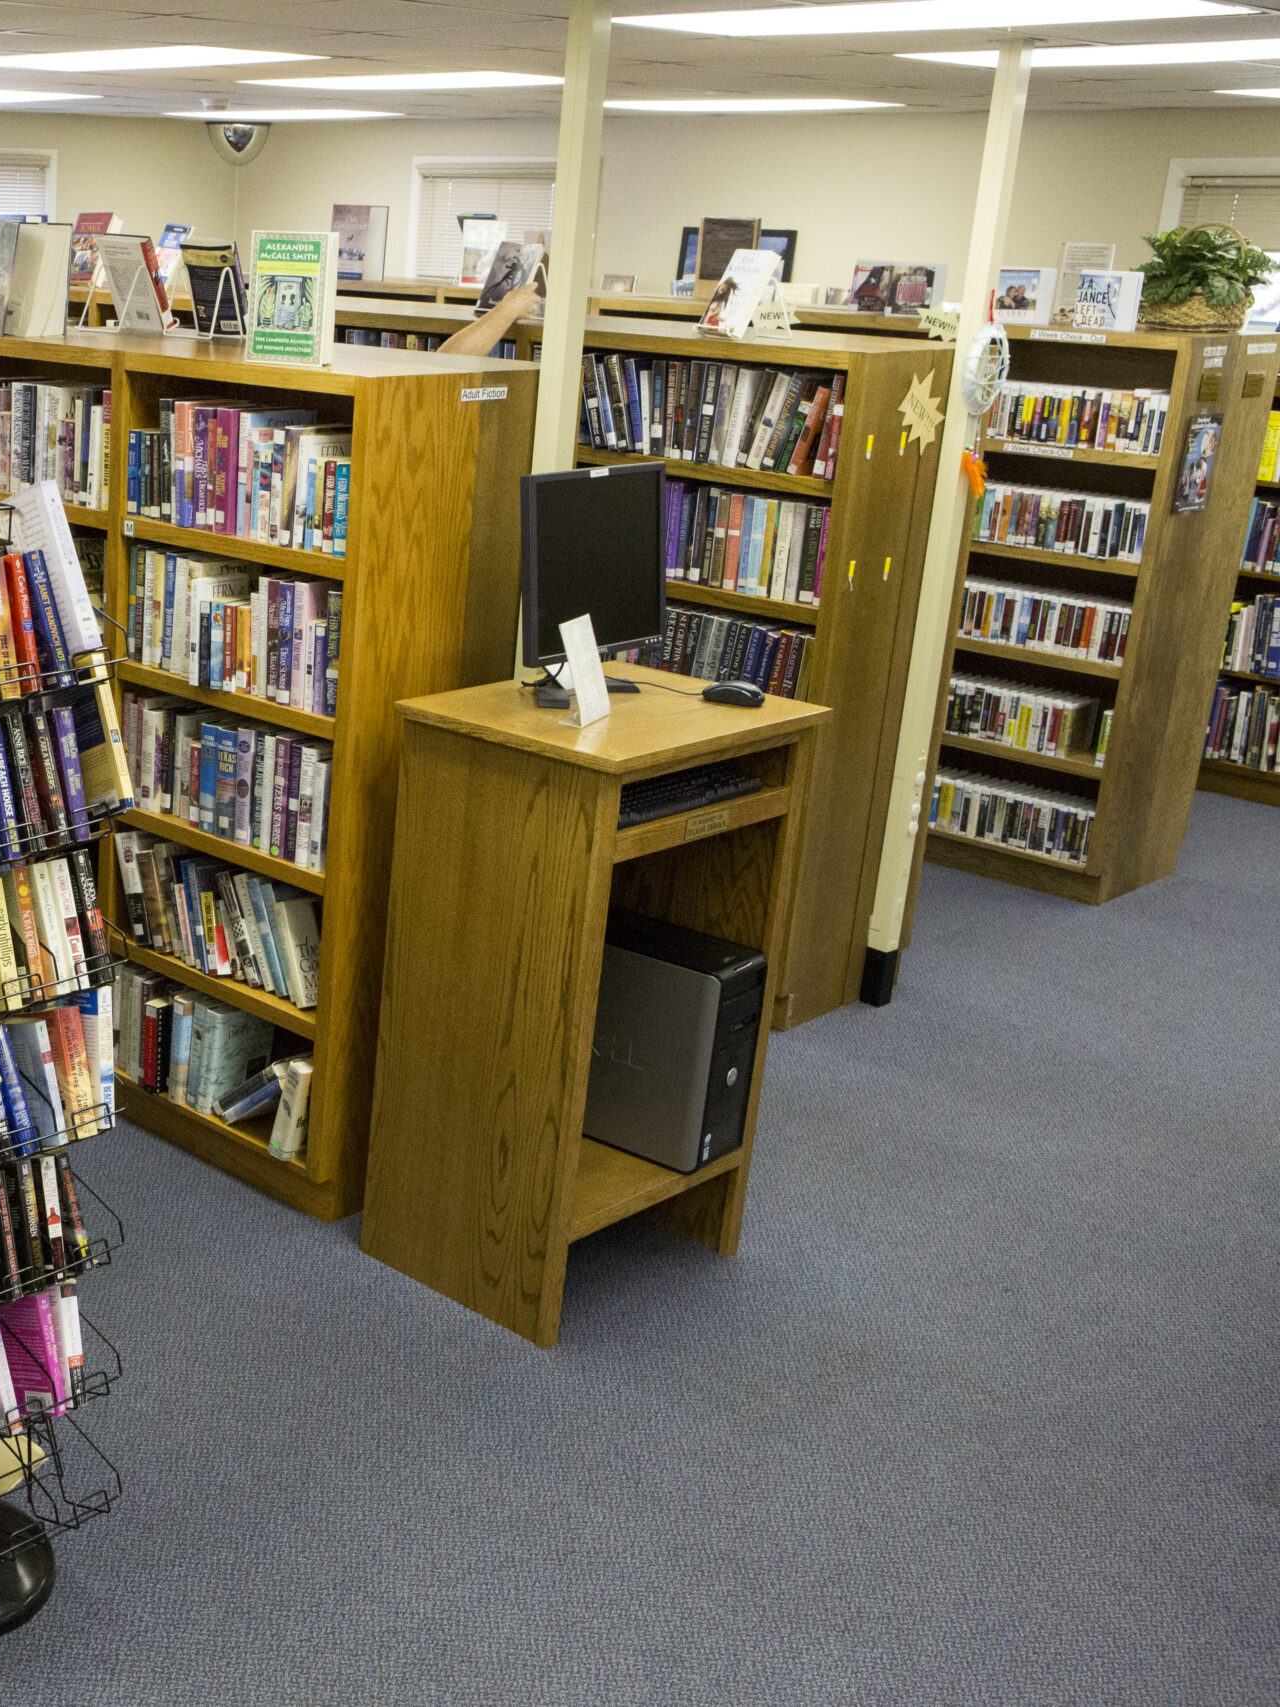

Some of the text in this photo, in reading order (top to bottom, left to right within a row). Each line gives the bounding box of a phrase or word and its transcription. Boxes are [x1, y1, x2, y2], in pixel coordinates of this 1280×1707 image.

[265, 242, 314, 251] ALEXANDER
[292, 253, 318, 261] SMITH
[1077, 291, 1108, 304] JANCE
[1075, 304, 1097, 315] LEFT
[924, 316, 957, 333] NEW!!!
[1081, 315, 1105, 328] DEAD
[1038, 331, 1058, 339] Week
[1059, 333, 1082, 341] Check
[462, 388, 505, 399] Adult Fiction
[908, 392, 935, 433] NEW!!!
[126, 523, 133, 533] M
[17, 576, 28, 618] Carly Phillips
[212, 585, 235, 598] FERN
[39, 584, 50, 605] JANET
[45, 606, 61, 647] EVANOVICH
[327, 615, 340, 656] FERN MICHAELS
[663, 626, 675, 661] GRAFTON
[673, 615, 687, 661] SUE GRAFTON
[774, 648, 784, 680] GRAFTON
[13, 727, 26, 765] ANNE RICE
[218, 750, 237, 763] TEXAS
[38, 736, 55, 790] CARLA NEGGERS
[219, 762, 234, 773] RICH
[1, 787, 14, 817] HOUSE
[272, 784, 283, 845] TEXAS SUNRISE
[80, 872, 92, 909] HOWARD
[86, 878, 96, 900] LINDA
[69, 937, 78, 953] Cold
[24, 1193, 39, 1237] IRIS JOHANSEN
